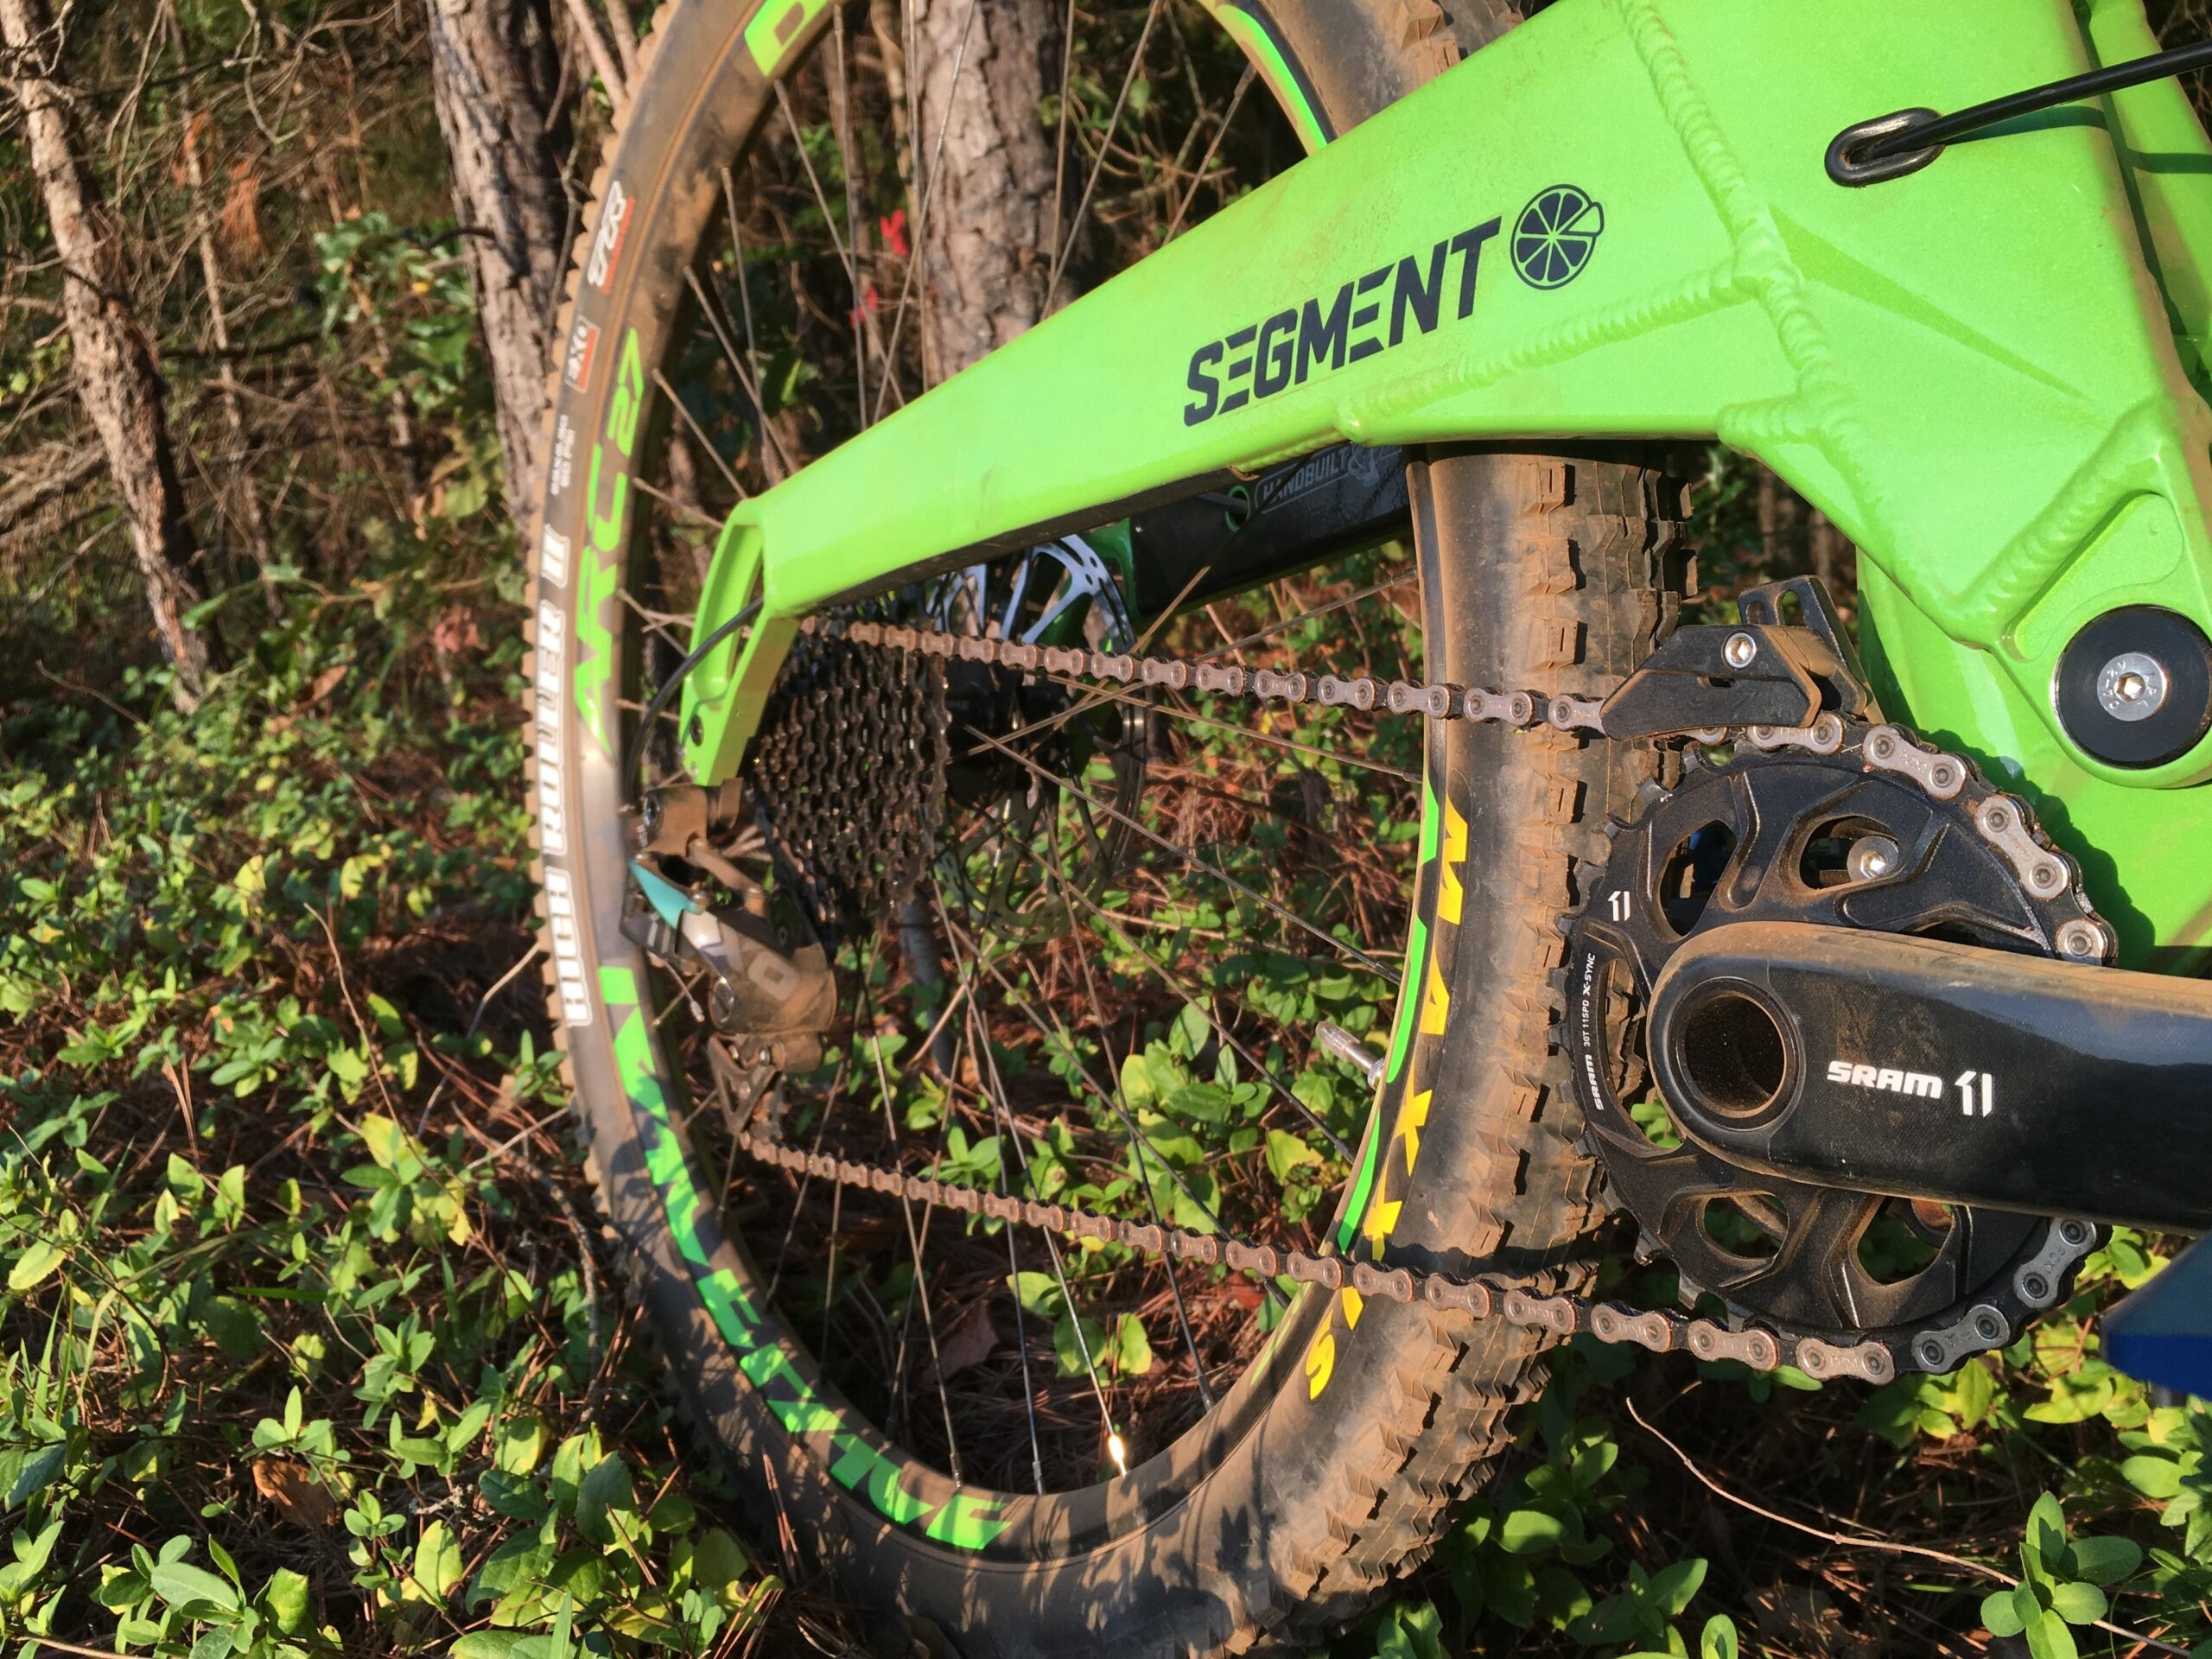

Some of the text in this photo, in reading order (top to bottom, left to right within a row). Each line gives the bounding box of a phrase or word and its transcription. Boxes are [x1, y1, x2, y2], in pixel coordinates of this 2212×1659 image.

[1184, 215, 1502, 426] SEGMENT
[607, 327, 645, 457] 27
[536, 599, 569, 855] ROLLER
[1607, 891, 1630, 921] 11
[543, 867, 592, 1027] HIGH
[1583, 952, 1596, 996] X-SYNC
[1581, 999, 1590, 1028] 11SPD
[1584, 1053, 1605, 1110] SRAM
[1827, 1060, 1993, 1118] SRAM 11
